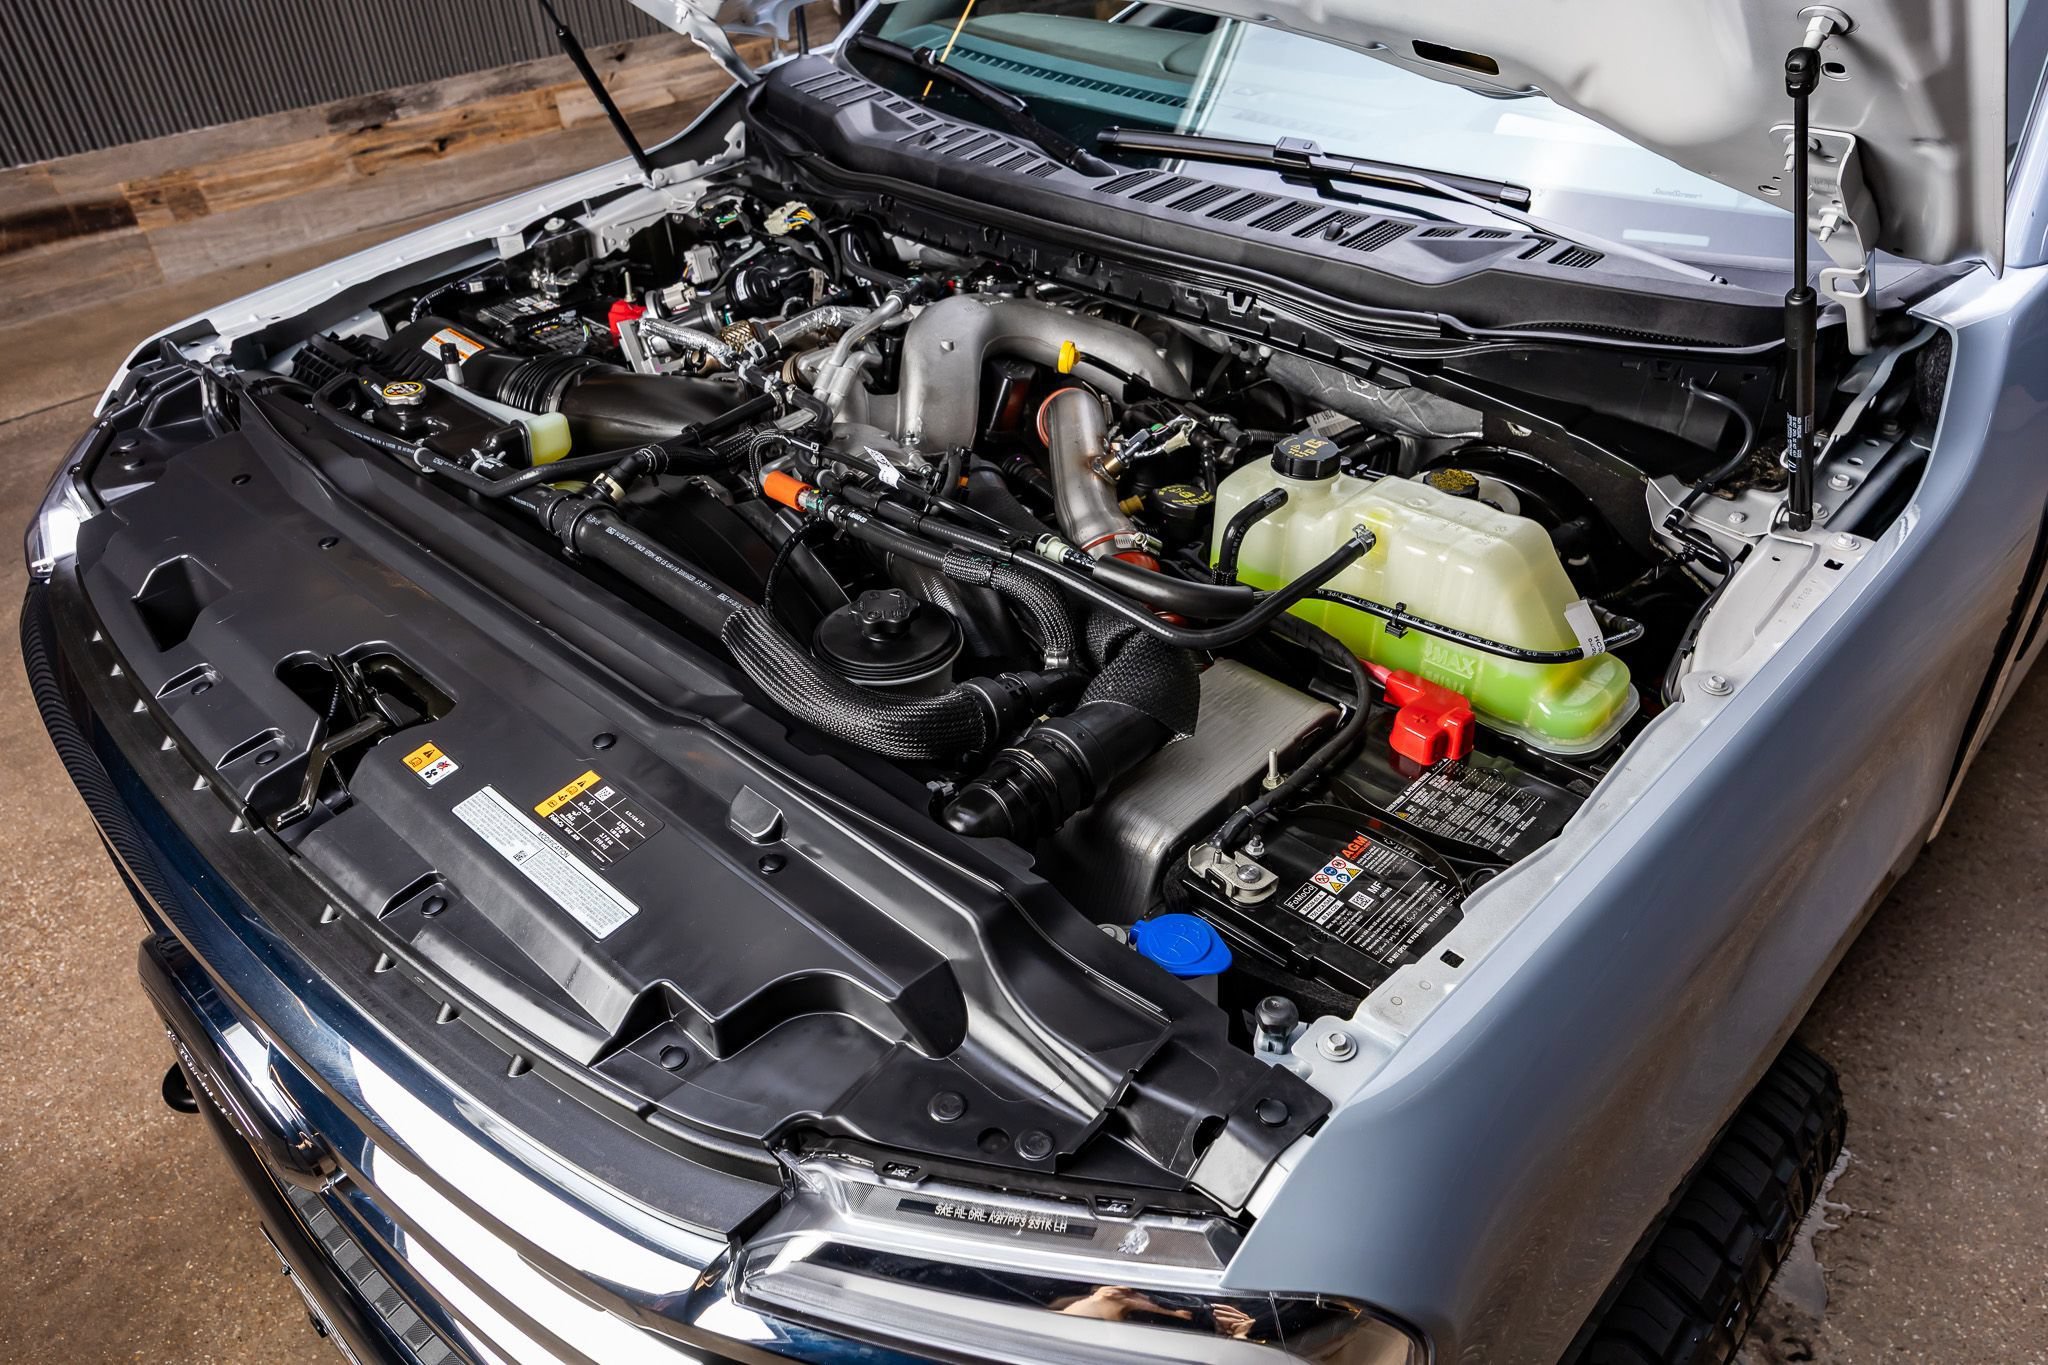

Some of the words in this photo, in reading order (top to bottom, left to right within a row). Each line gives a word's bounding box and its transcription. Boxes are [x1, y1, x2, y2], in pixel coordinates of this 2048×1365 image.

[1327, 588, 1343, 599] TYPE
[547, 813, 565, 828] FoMoCo
[563, 826, 574, 834] SAE
[564, 812, 576, 821] PAG
[537, 830, 570, 859] MODIFICATION
[1339, 834, 1368, 858] AGM
[1287, 883, 1314, 908] FoMoCo
[1366, 880, 1384, 894] MF
[1390, 950, 1401, 959] NOT
[1409, 931, 1420, 940] PAS
[934, 1205, 954, 1217] SAE
[954, 1208, 968, 1219] HL
[968, 1209, 987, 1222] DRL
[1053, 1221, 1068, 1233] LH
